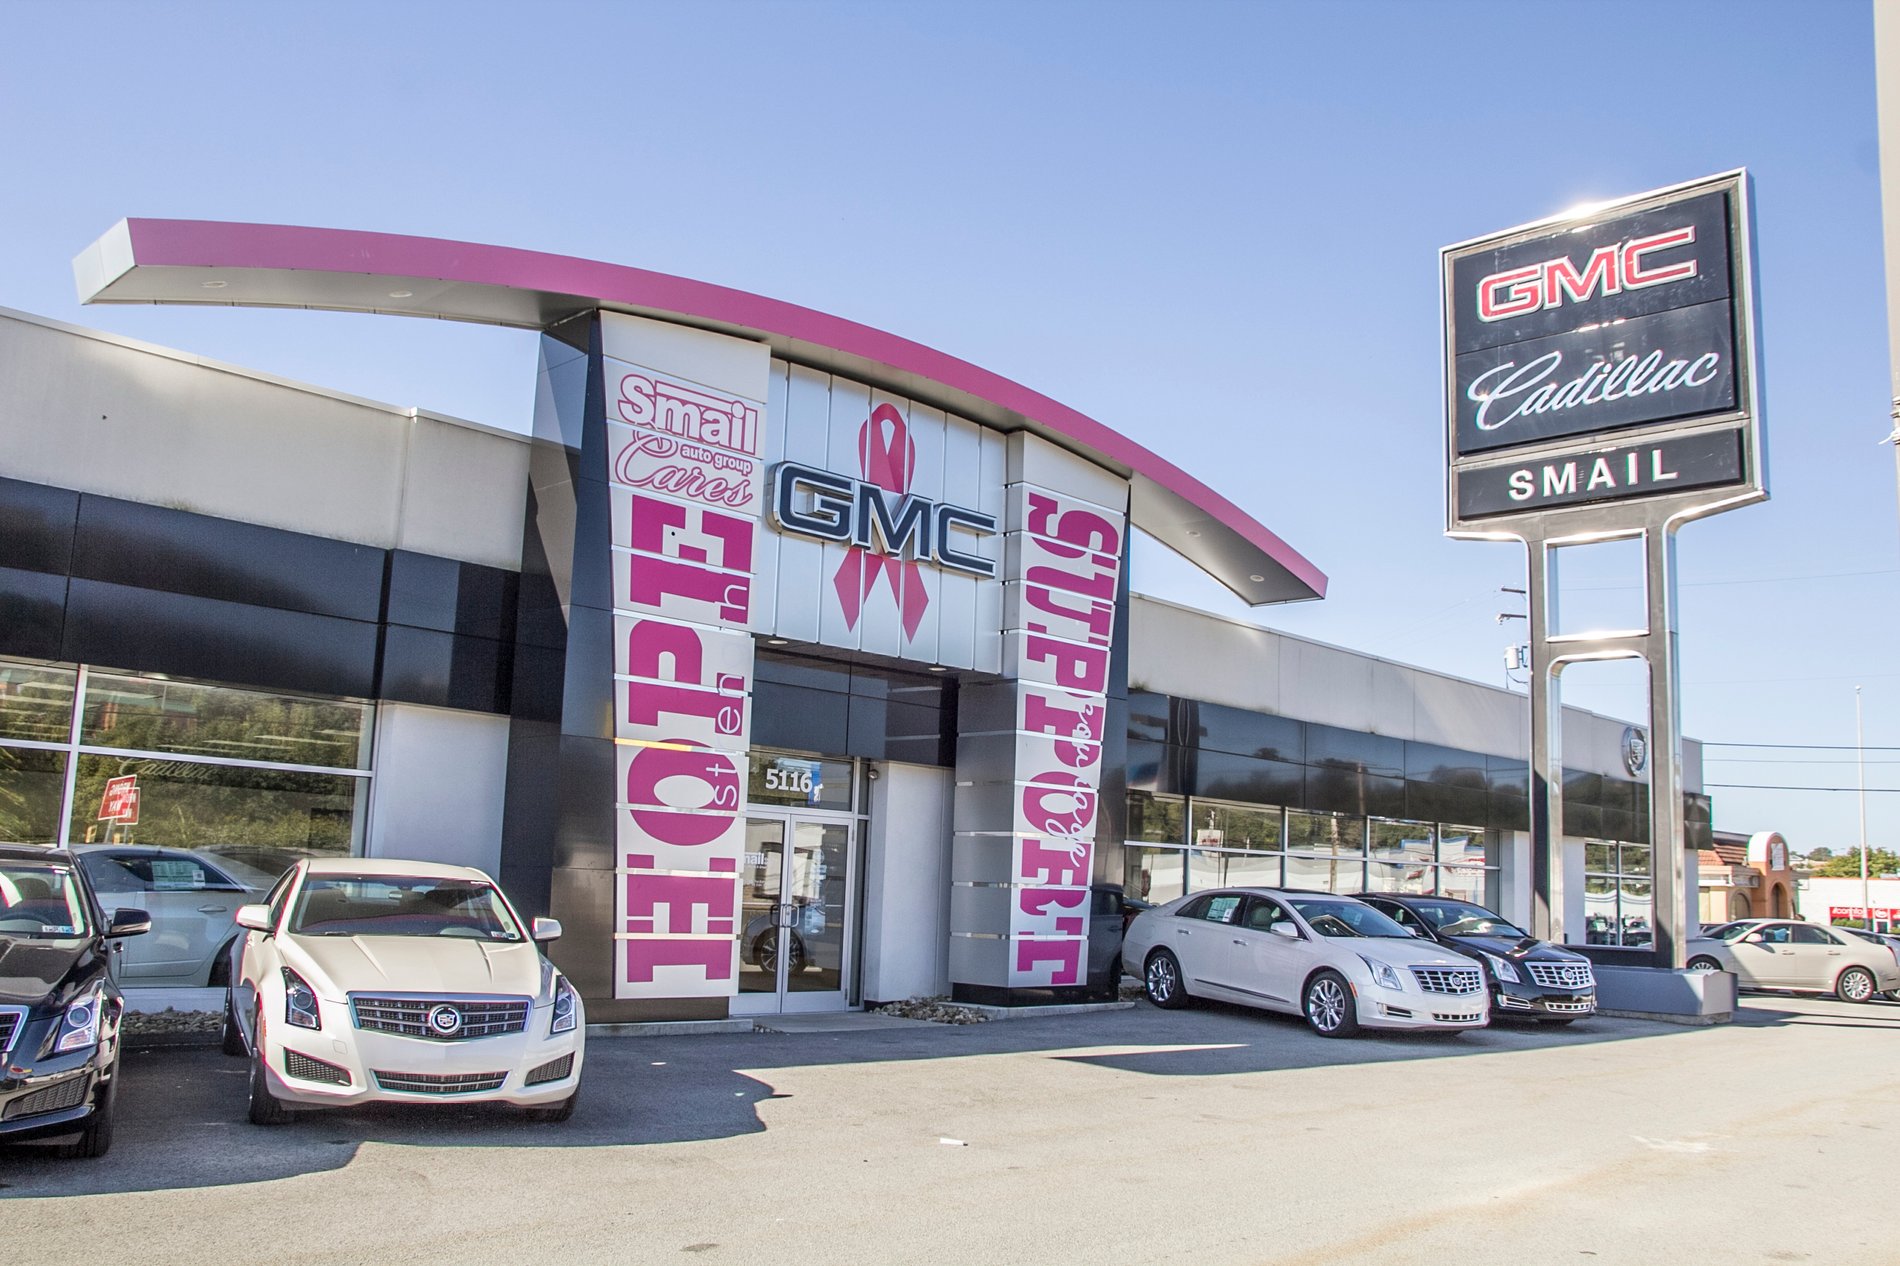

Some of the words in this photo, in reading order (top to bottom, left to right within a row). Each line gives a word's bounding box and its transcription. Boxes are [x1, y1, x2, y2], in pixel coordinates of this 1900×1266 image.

[1476, 225, 1698, 323] GMC
[618, 374, 757, 455] Smail
[1467, 350, 1720, 431] Cadillac
[615, 429, 753, 507] Cares
[681, 444, 712, 463] auto
[713, 452, 752, 477] group
[1508, 449, 1678, 501] SMAIL
[768, 461, 997, 579] GMC
[626, 494, 754, 983] HOPE
[1016, 492, 1120, 986] SUPPORT
[765, 769, 814, 794] 5116
